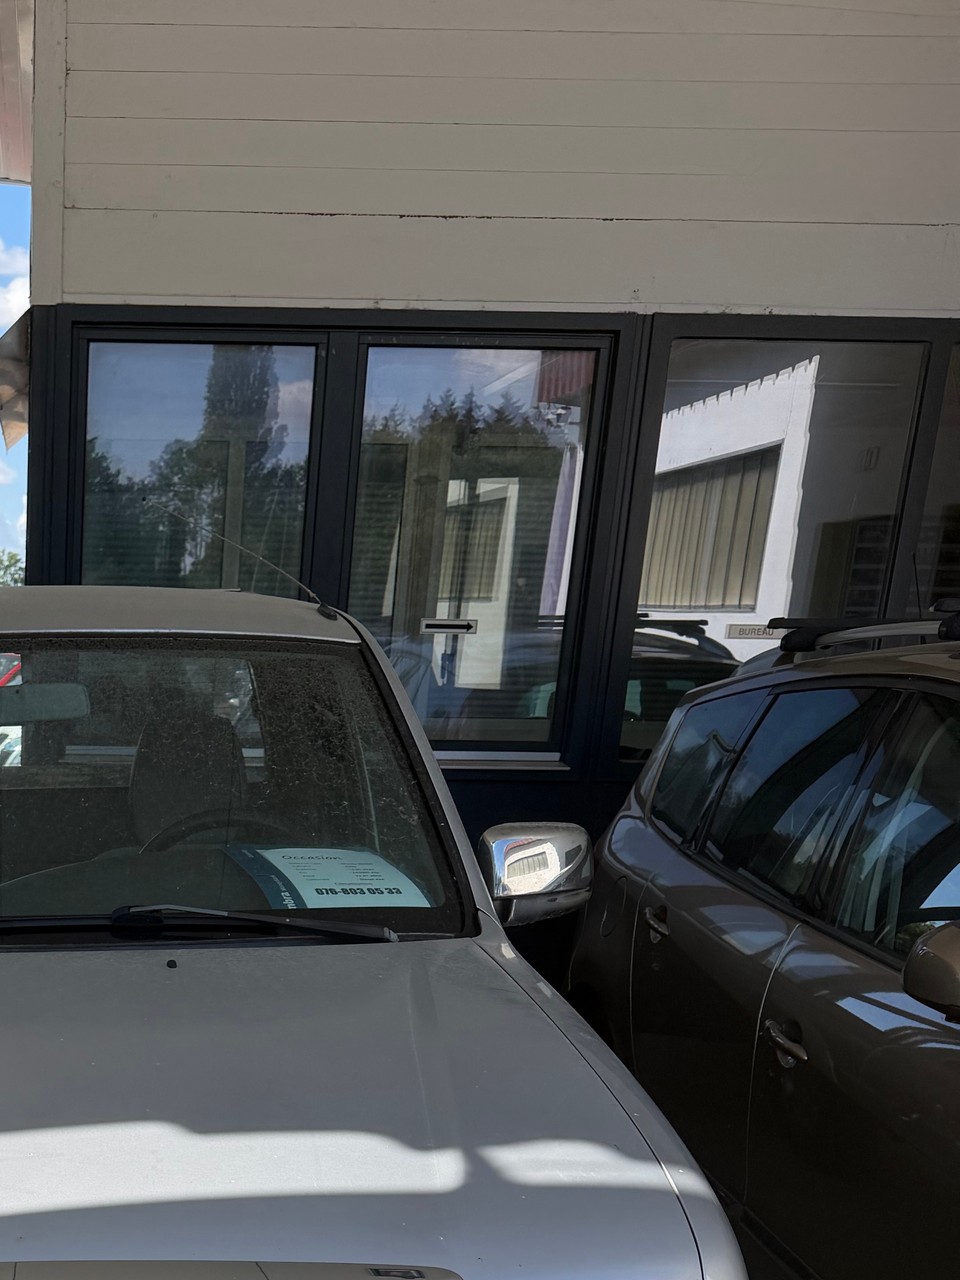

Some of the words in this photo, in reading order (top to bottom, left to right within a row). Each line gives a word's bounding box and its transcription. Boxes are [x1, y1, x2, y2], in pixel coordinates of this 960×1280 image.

[739, 628, 774, 636] BUREAU
[314, 887, 366, 896] 076-803
[366, 887, 385, 895] 05
[385, 887, 403, 895] 33
